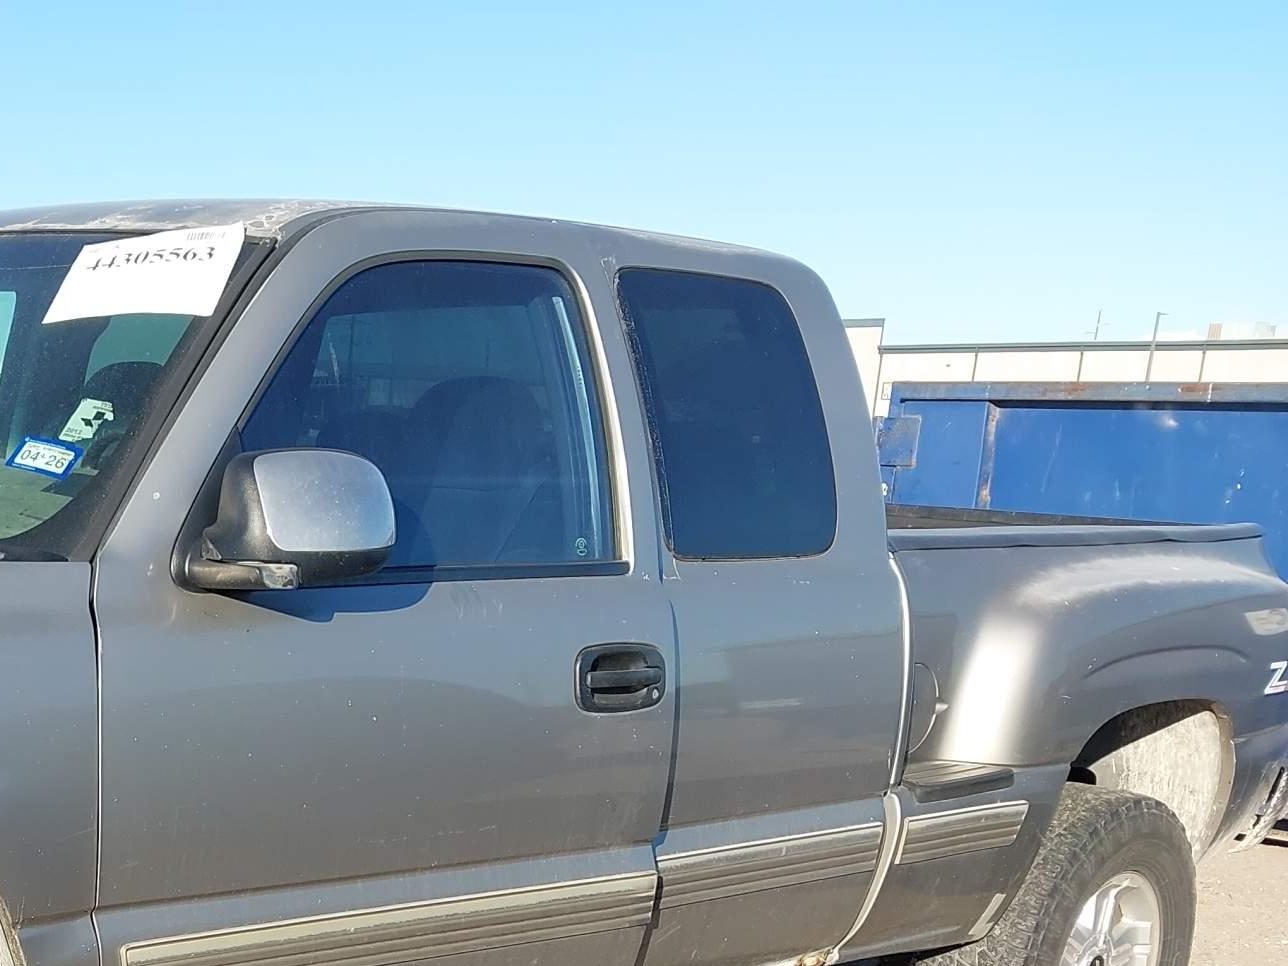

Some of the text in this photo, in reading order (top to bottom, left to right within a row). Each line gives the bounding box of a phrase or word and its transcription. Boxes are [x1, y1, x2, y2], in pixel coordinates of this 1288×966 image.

[86, 246, 216, 271] 44305563
[20, 449, 41, 463] 04
[44, 454, 67, 469] 26
